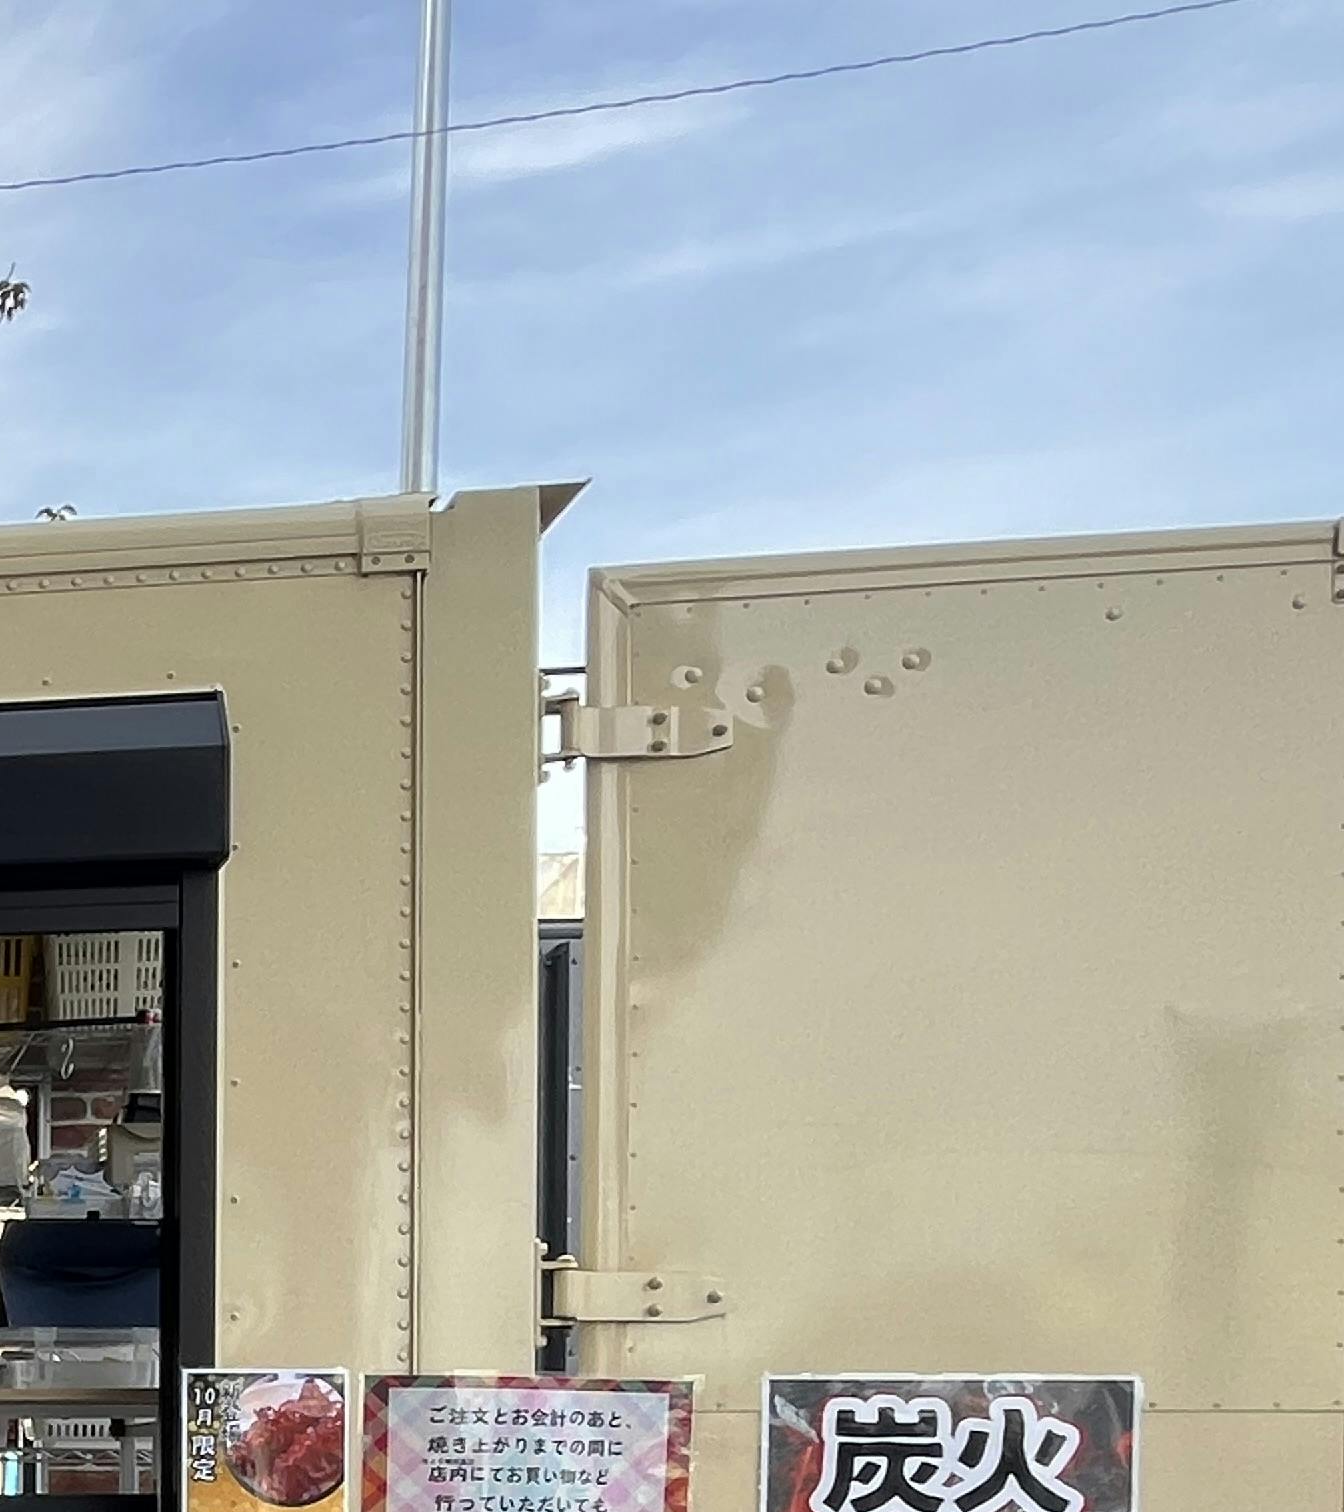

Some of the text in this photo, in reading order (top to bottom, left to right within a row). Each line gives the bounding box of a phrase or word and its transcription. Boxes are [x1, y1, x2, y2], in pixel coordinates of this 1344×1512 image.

[429, 1404, 632, 1429] ご注文とお会計のあと、
[192, 1387, 216, 1481] 10月限定
[427, 1435, 624, 1457] 焼き上がりまでの間に
[428, 1466, 610, 1486] 店内にてお買い物など
